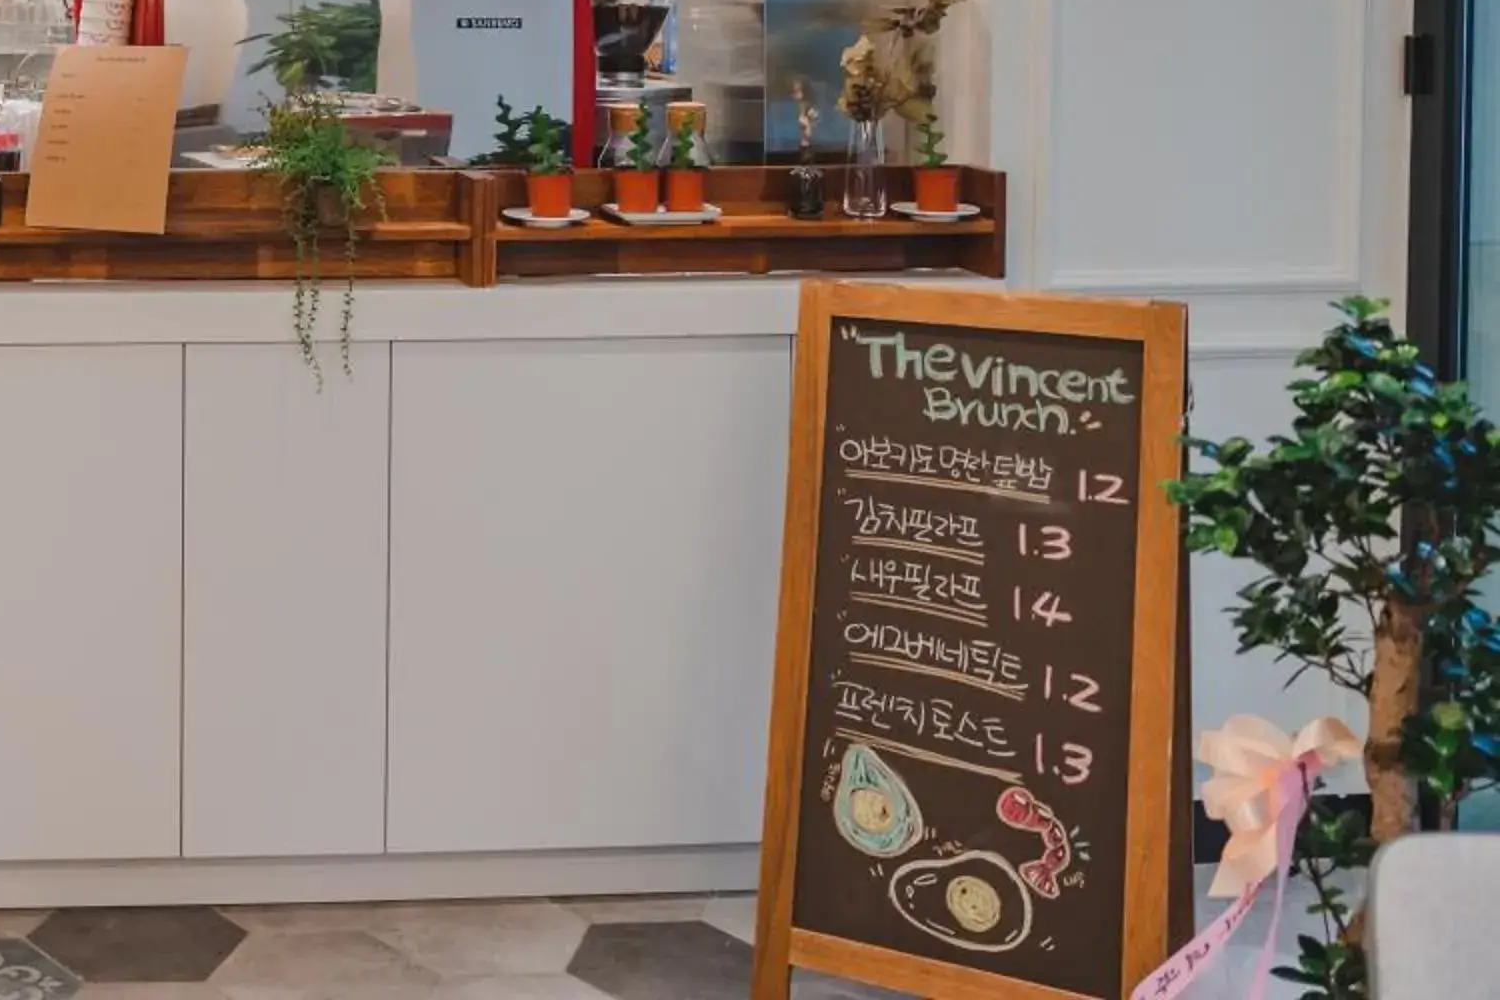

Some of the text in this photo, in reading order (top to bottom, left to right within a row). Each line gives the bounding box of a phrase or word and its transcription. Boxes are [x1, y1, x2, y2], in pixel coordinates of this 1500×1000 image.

[1077, 469, 1131, 505] 1.2
[1018, 523, 1073, 560] 1.3
[1043, 665, 1102, 713] 1.2
[1035, 732, 1094, 784] 1.3
